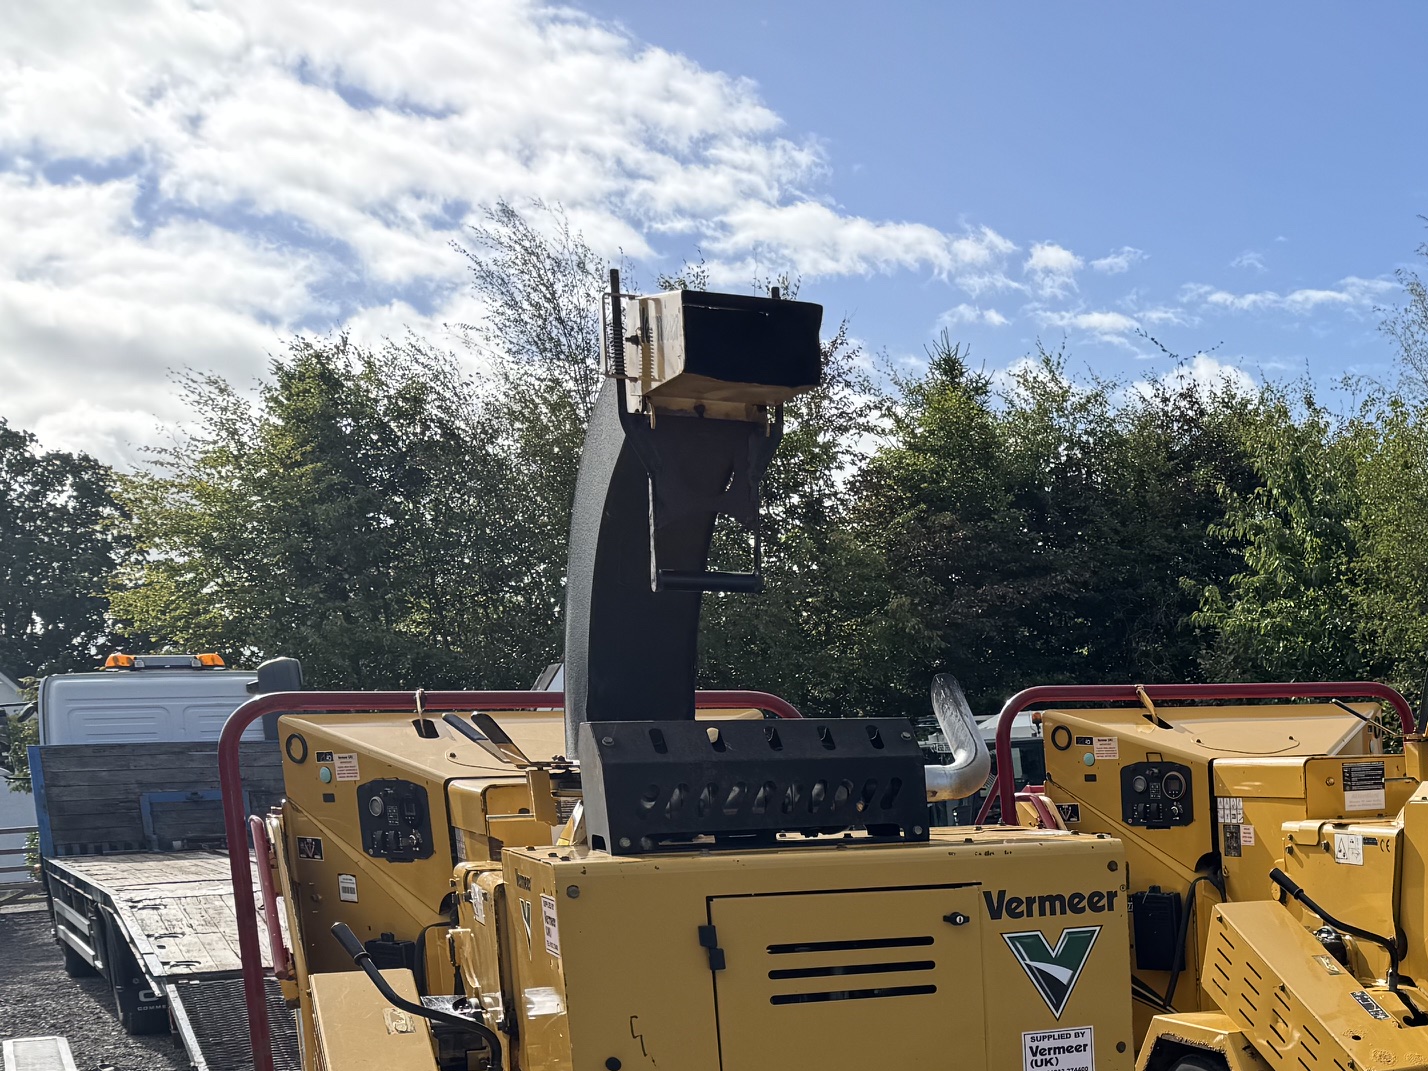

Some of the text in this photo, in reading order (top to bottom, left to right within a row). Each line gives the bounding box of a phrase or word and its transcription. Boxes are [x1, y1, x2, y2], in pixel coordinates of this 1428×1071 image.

[983, 889, 1117, 920] Vermeer
[1030, 1033, 1071, 1042] SUPPLIED
[1029, 1044, 1088, 1057] Vermeer
[1030, 1057, 1059, 1069] (UK)
